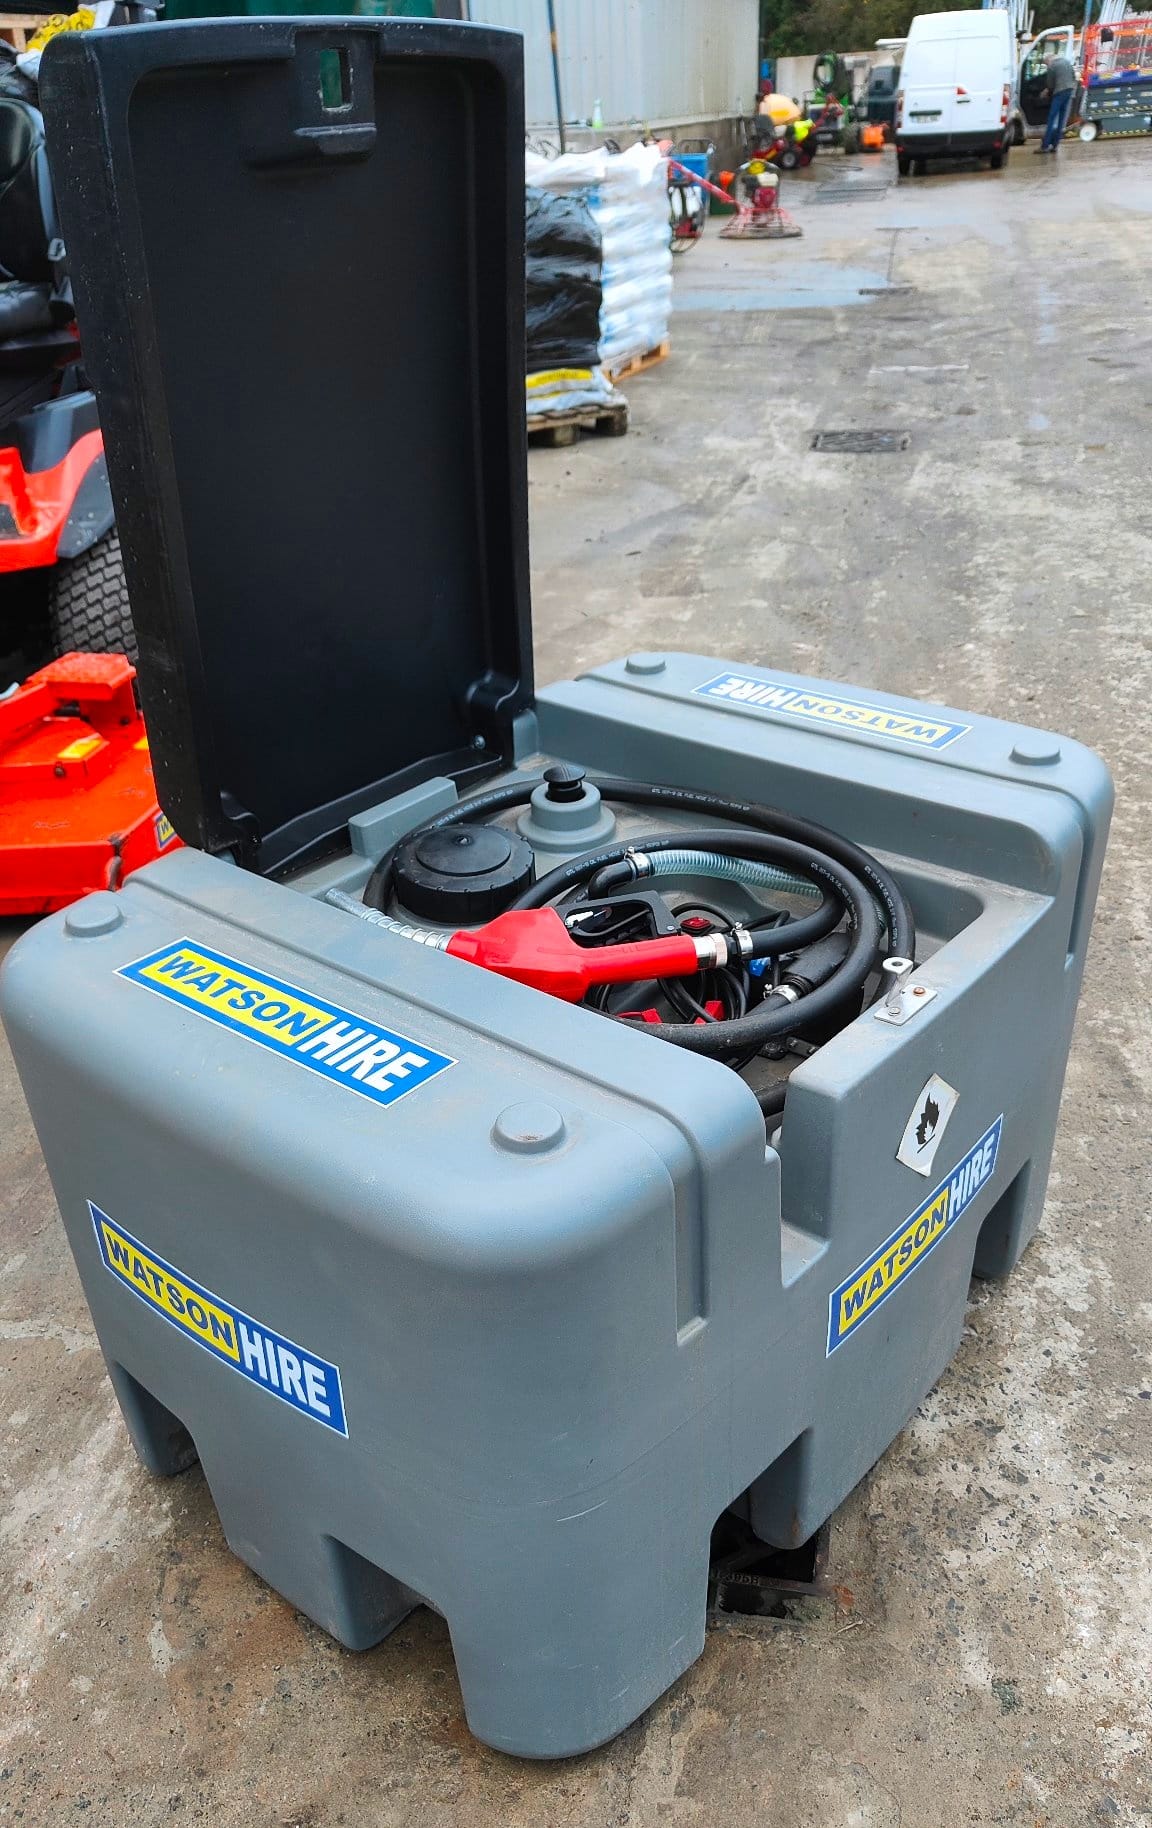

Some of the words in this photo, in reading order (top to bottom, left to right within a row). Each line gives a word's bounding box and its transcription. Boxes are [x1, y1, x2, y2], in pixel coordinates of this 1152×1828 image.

[708, 678, 798, 707] HIRE
[793, 699, 938, 738] WATSON
[158, 956, 320, 1036] WATSON
[297, 1020, 430, 1091] HIRE
[844, 1199, 947, 1320] WATSON
[948, 1133, 994, 1221] HIRE
[106, 1231, 234, 1350] WATSON
[239, 1321, 331, 1417] HIRE
